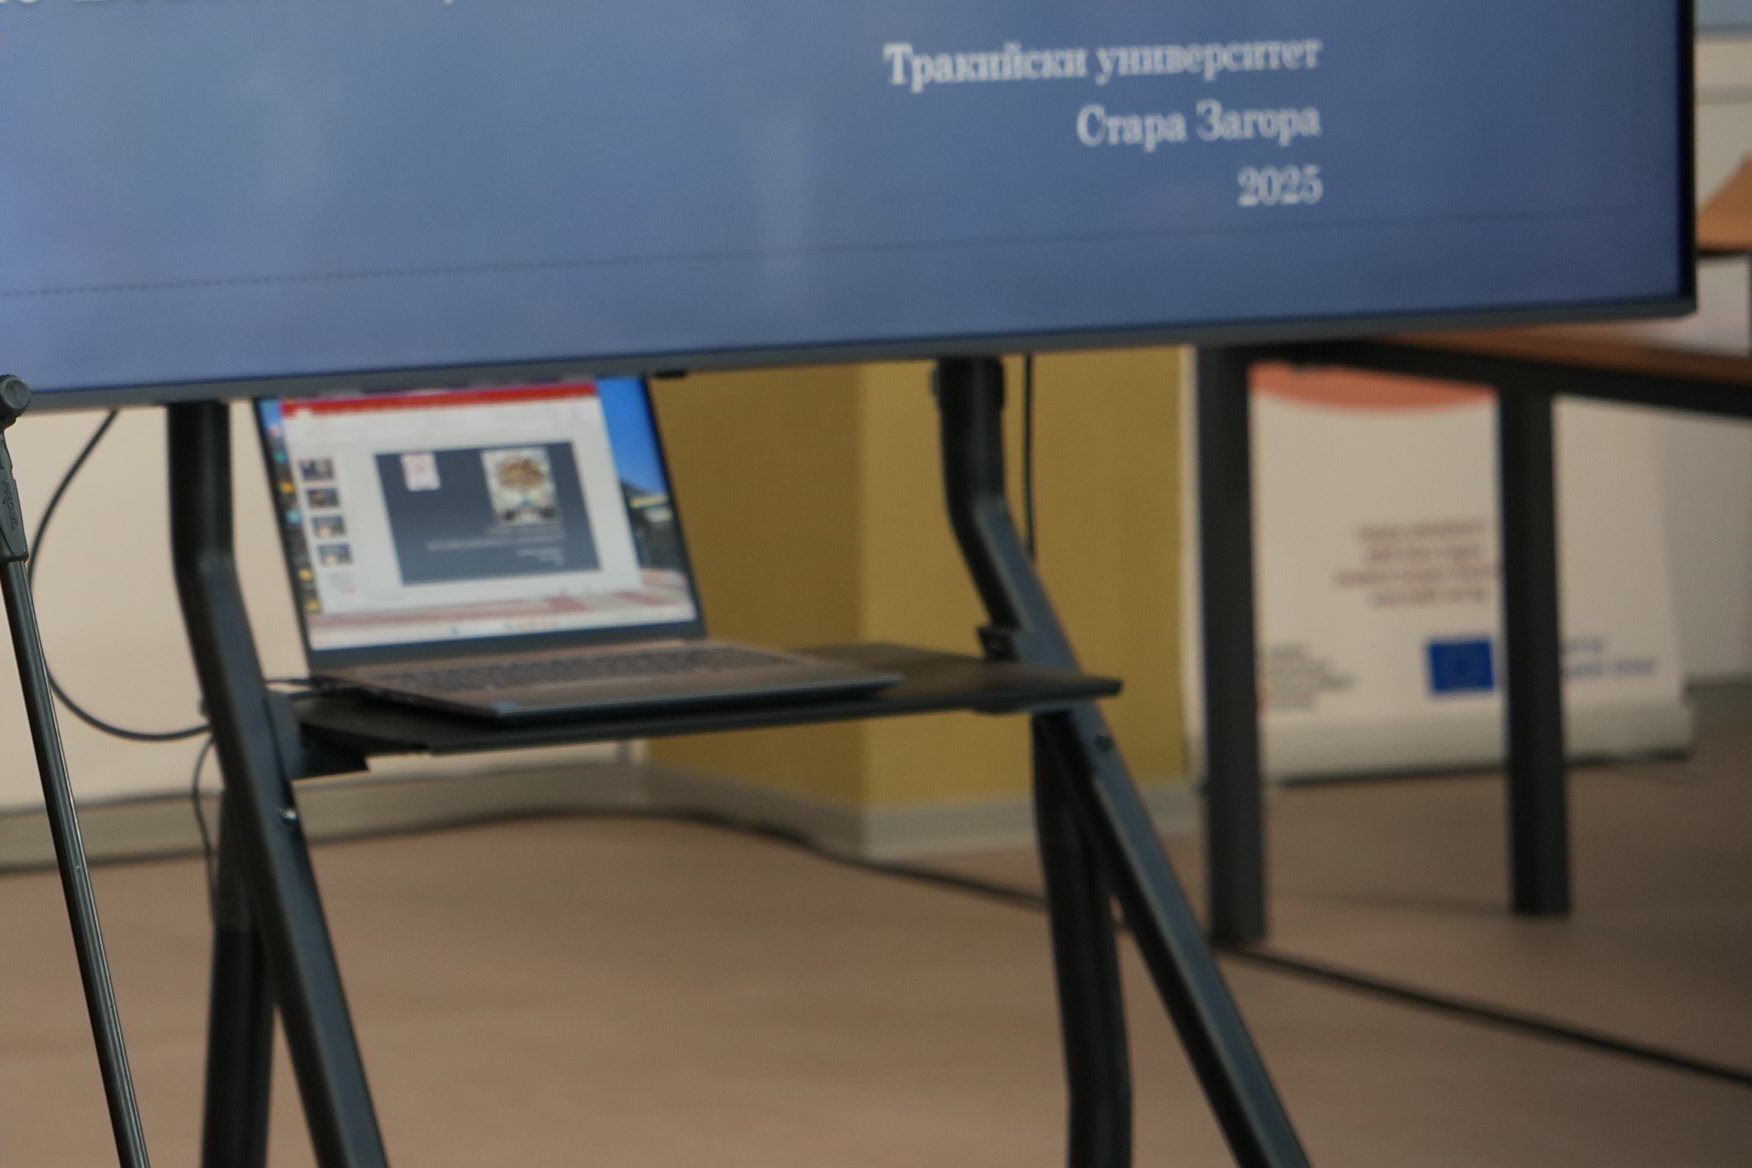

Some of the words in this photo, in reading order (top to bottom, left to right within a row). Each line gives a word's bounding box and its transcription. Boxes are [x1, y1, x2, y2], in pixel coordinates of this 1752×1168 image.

[883, 41, 1087, 94] Тракийски
[1095, 39, 1324, 85] университет
[1077, 104, 1187, 153] Стара
[1195, 98, 1322, 147] Загора
[1237, 164, 1324, 207] 2025
